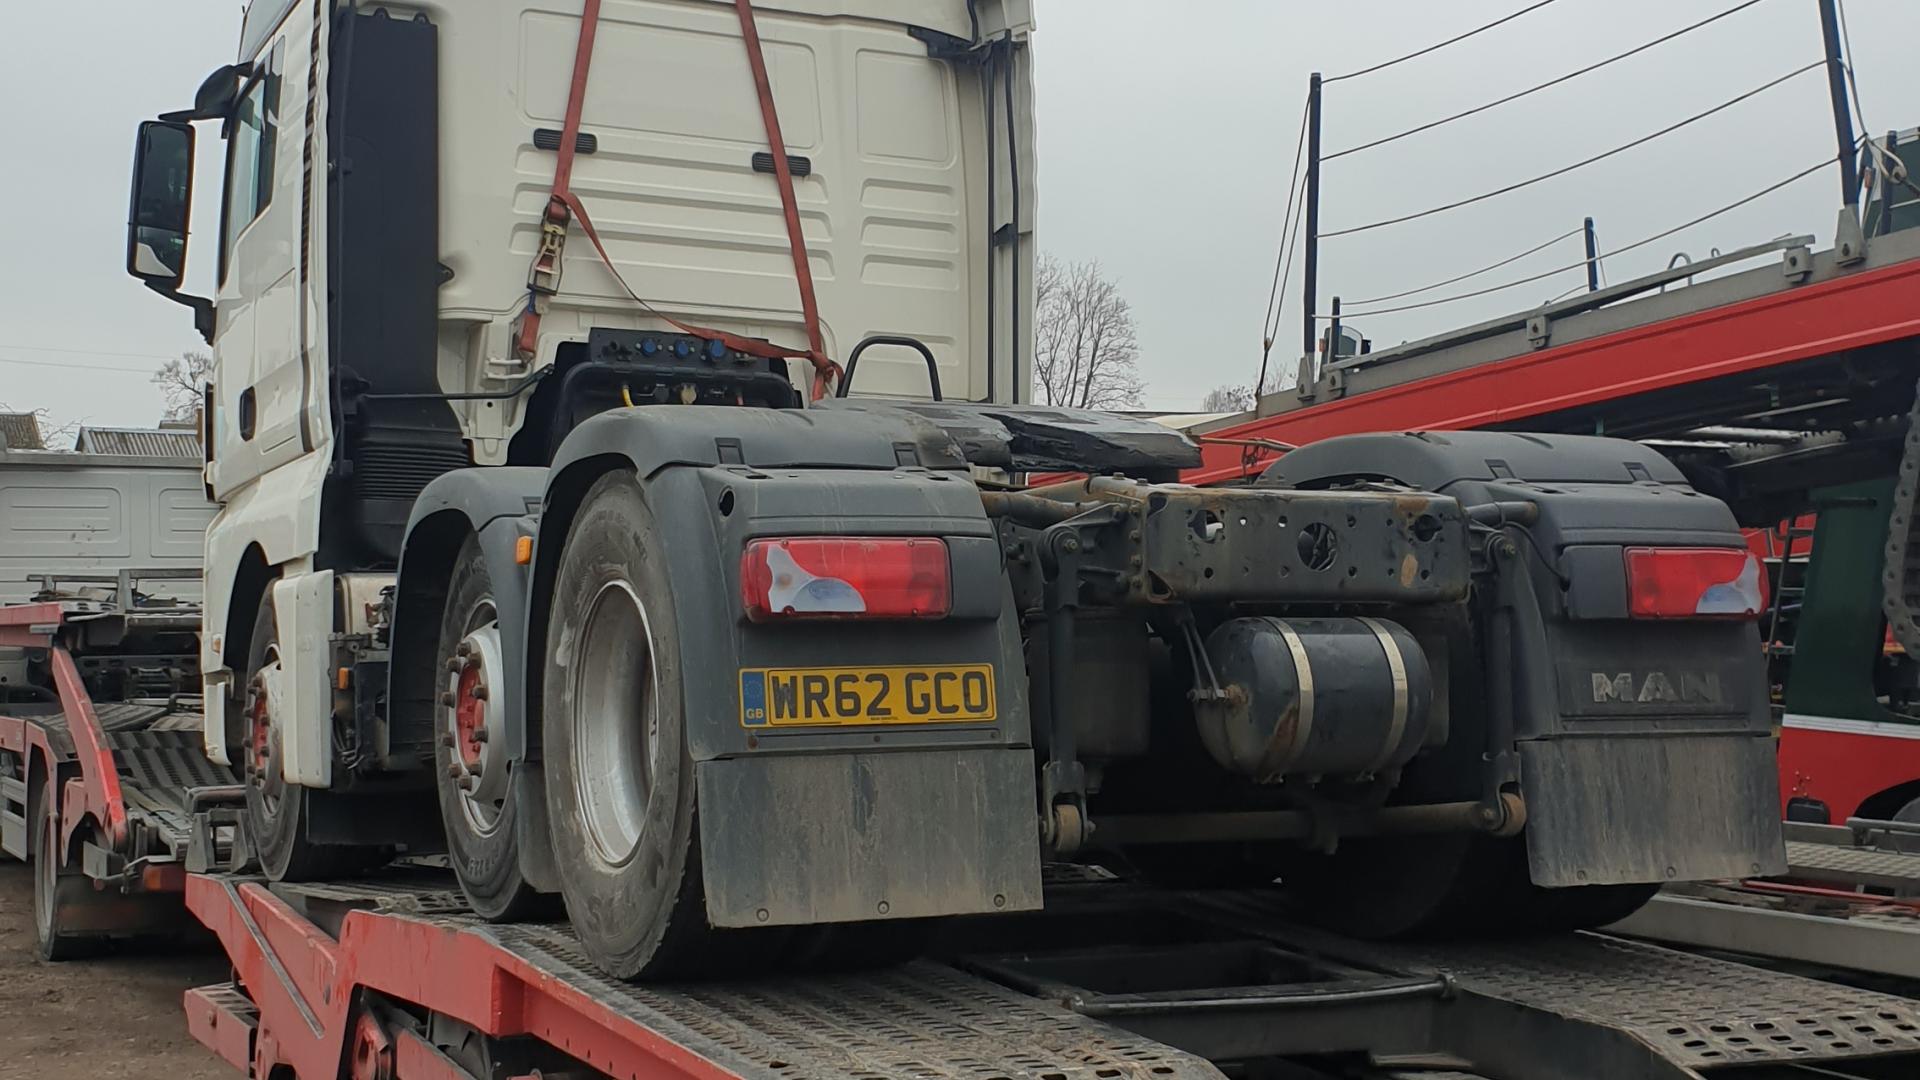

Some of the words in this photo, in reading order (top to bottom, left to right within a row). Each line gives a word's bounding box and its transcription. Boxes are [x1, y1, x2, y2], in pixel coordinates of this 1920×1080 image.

[771, 673, 892, 719] WR62
[905, 671, 988, 715] GCO
[1592, 672, 1722, 702] MAN
[746, 708, 764, 719] GB
